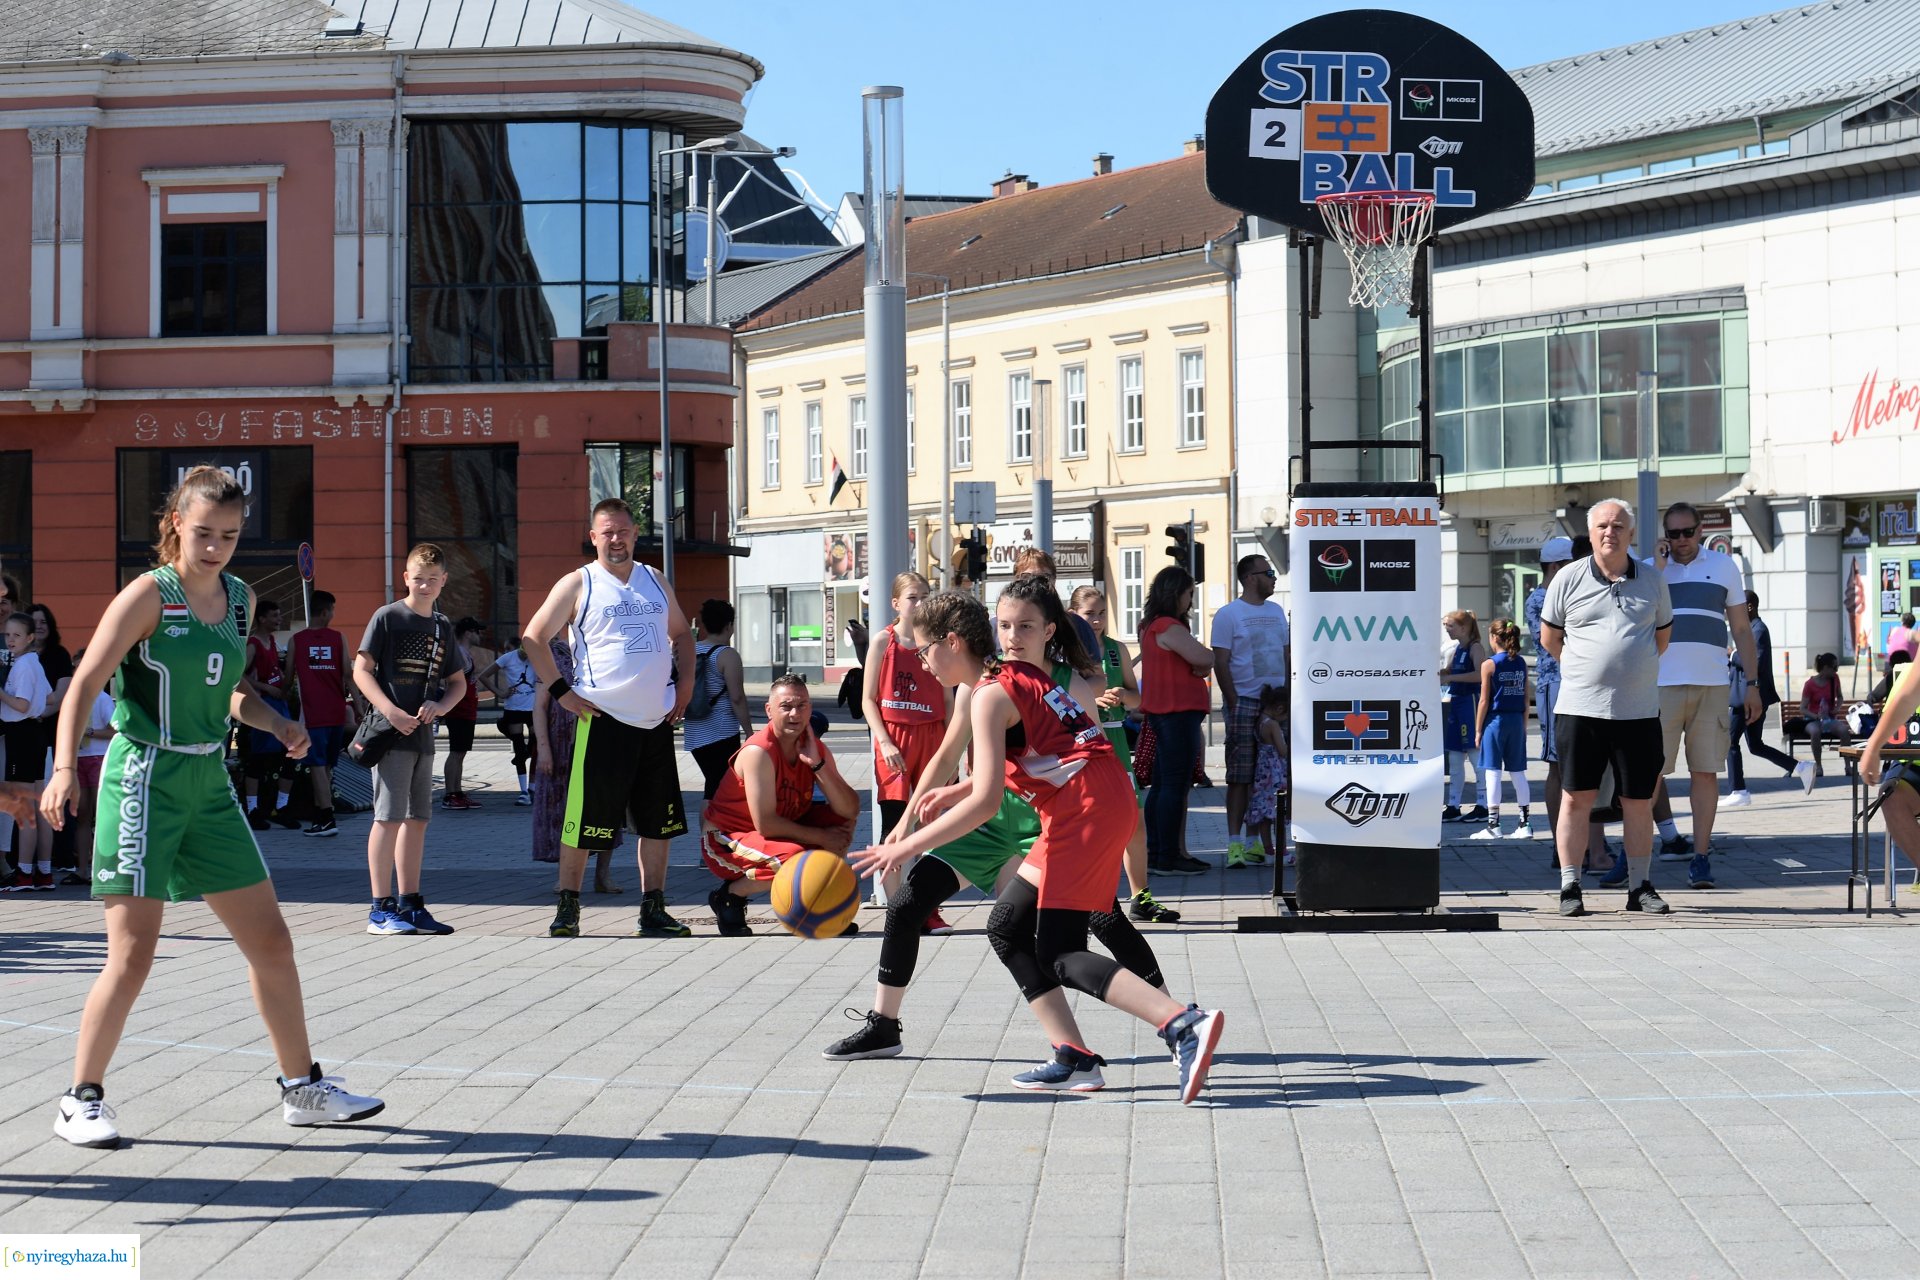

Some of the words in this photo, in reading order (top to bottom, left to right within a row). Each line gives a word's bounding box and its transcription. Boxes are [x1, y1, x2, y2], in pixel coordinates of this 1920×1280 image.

[1263, 120, 1287, 148] 2
[1427, 140, 1464, 155] TOTI
[1300, 151, 1476, 208] BALL
[240, 407, 493, 440] FASHION
[1294, 507, 1438, 528] STREETBALL
[1369, 561, 1411, 569] MKOSZ
[602, 599, 664, 619] adidas
[620, 622, 661, 655] 21
[1312, 615, 1418, 642] MVM
[205, 652, 224, 686] 9
[1311, 668, 1328, 678] GB
[1335, 668, 1427, 678] GROSBASKET
[1460, 724, 1468, 737] 8
[1342, 792, 1411, 820] TOTI
